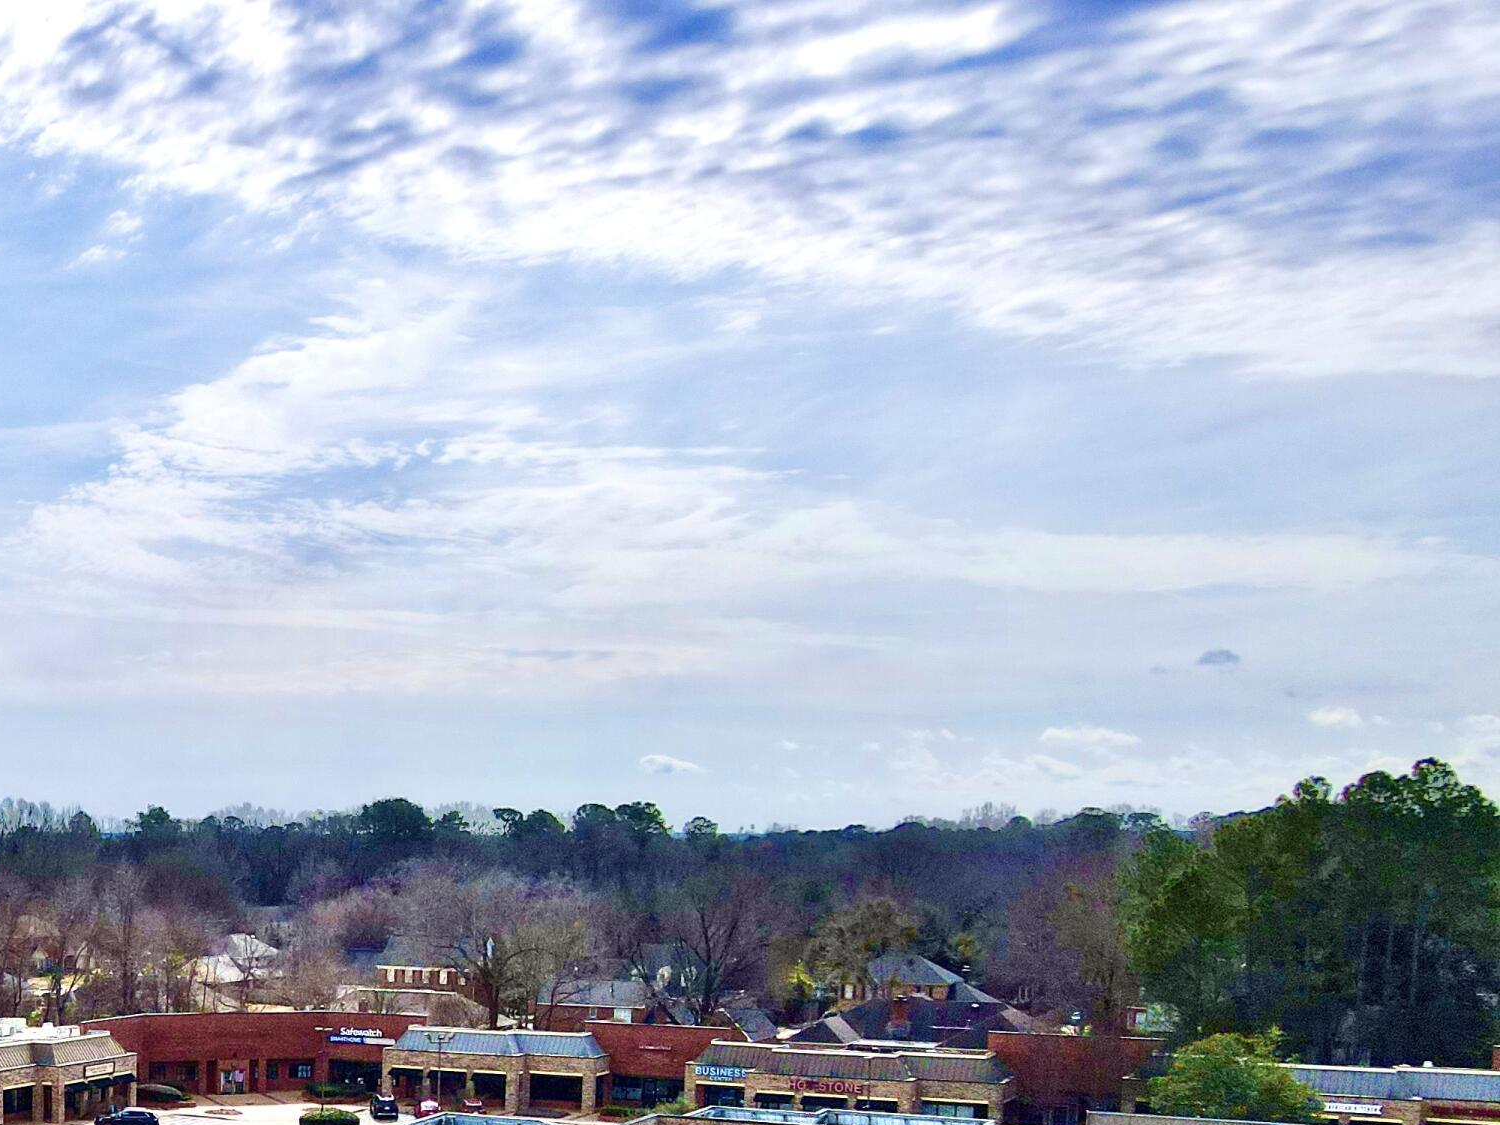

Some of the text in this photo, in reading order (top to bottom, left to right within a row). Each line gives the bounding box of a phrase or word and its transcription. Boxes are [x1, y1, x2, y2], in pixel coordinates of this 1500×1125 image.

[340, 1027, 382, 1037] Safewatch
[695, 1066, 746, 1077] BUSINESS
[819, 1082, 862, 1093] STONE
